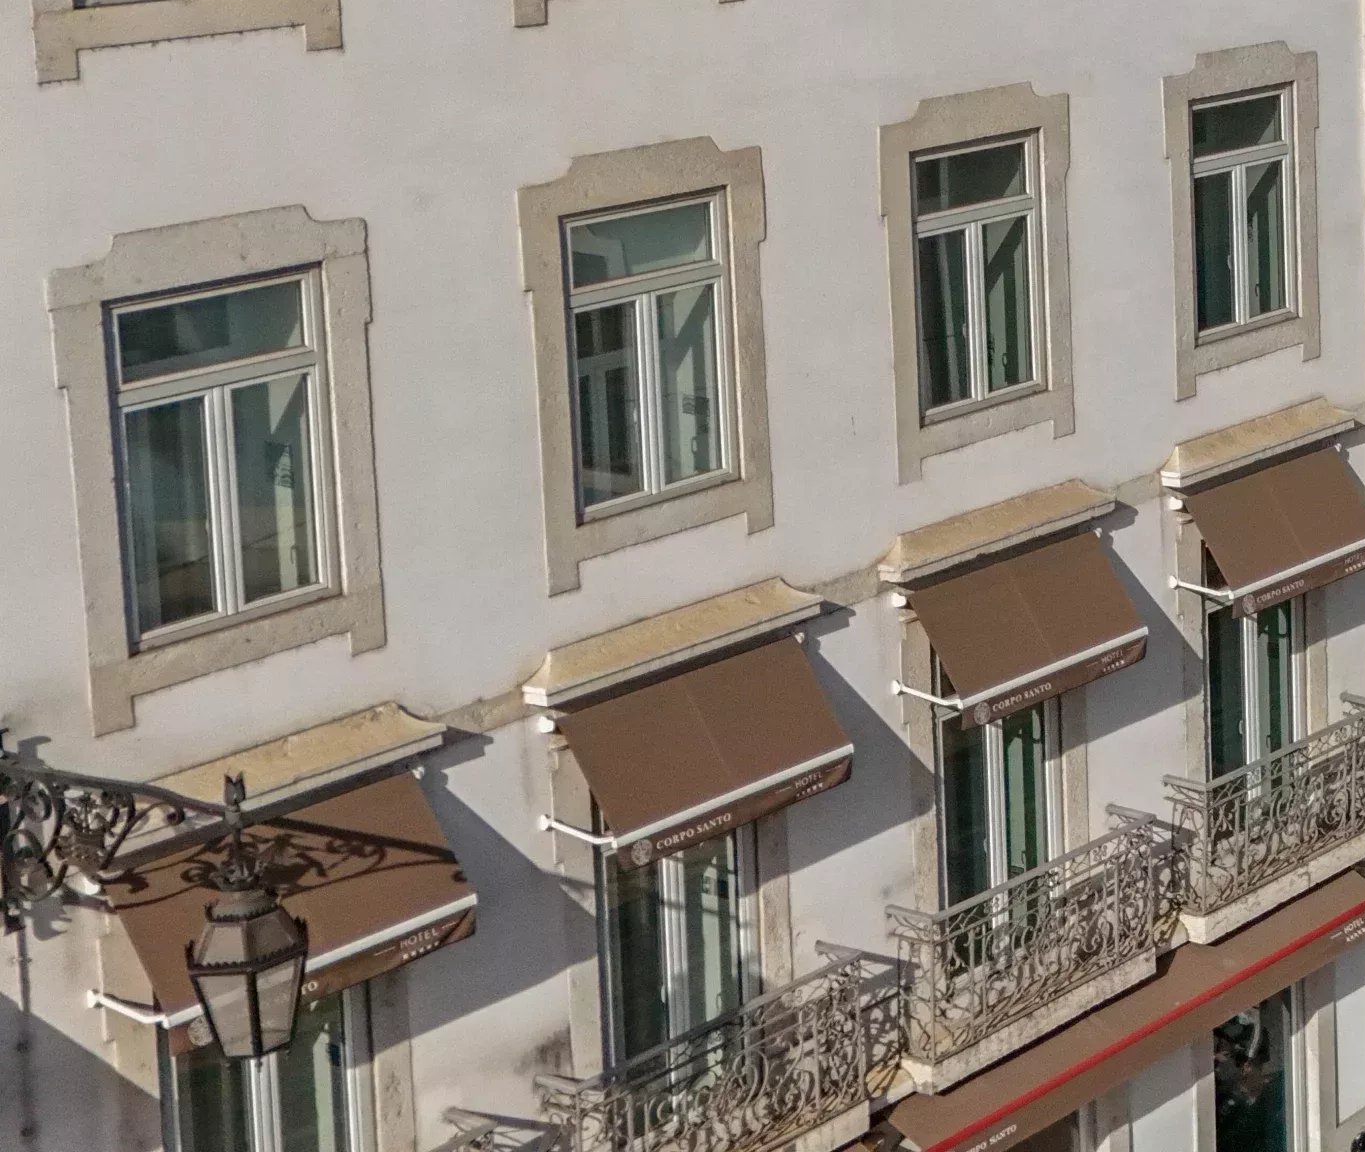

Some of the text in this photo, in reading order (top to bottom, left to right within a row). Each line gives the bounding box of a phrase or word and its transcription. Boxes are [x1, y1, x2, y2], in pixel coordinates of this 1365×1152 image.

[1256, 579, 1305, 604] CORPO SANTO
[992, 683, 1052, 713] CORPO SANTO
[794, 771, 823, 789] HOTEL
[656, 813, 732, 850] CORPO SANTO
[1344, 918, 1364, 934] HOTEL
[400, 928, 440, 948] HOTEL
[989, 1124, 1017, 1145] SANTO
